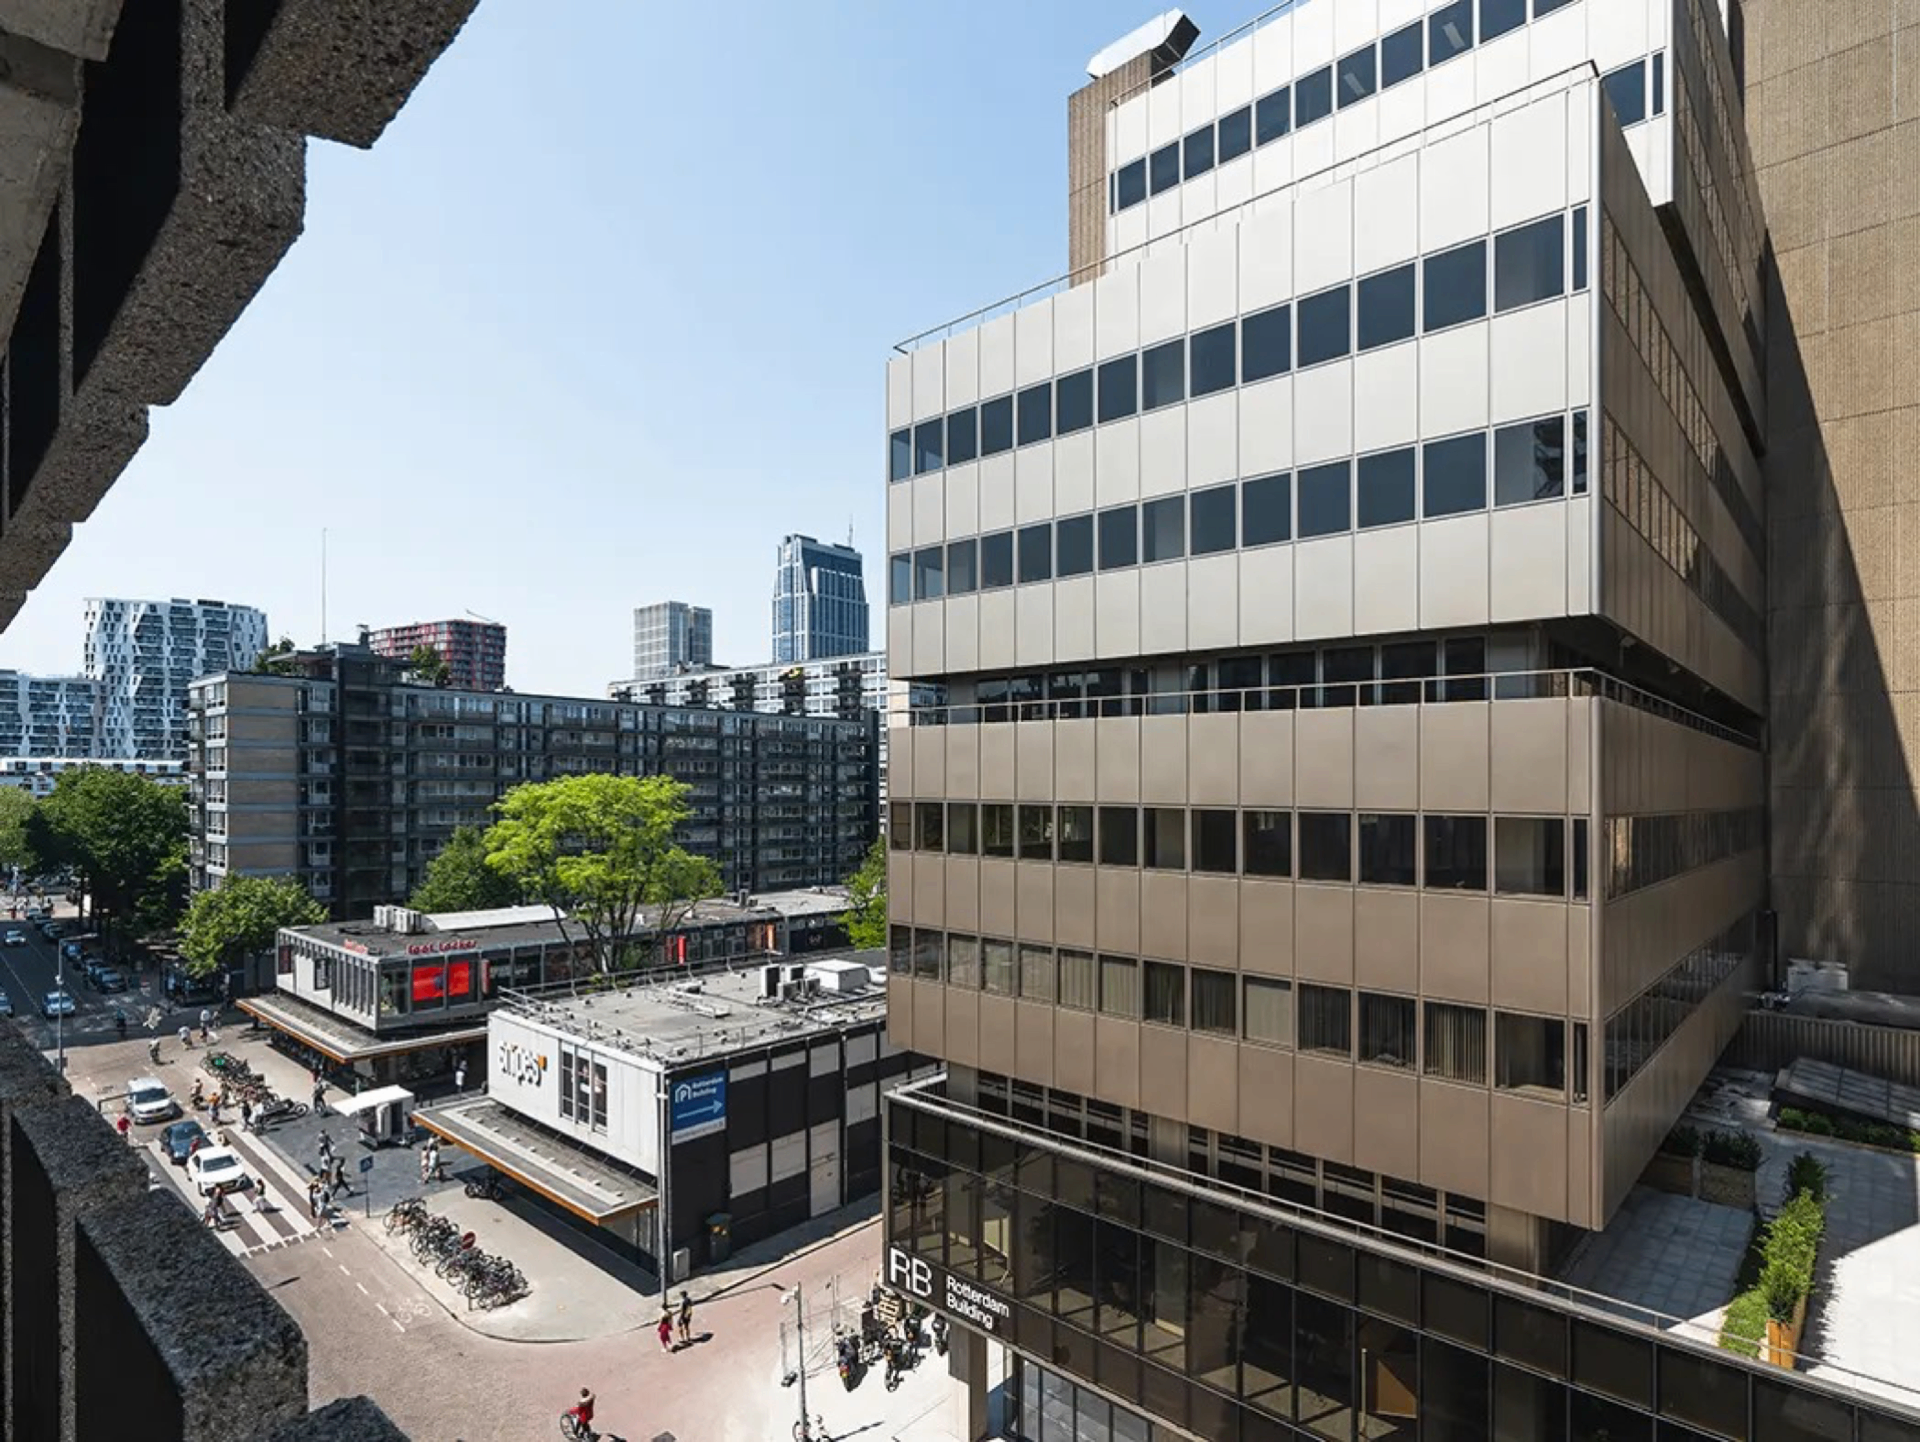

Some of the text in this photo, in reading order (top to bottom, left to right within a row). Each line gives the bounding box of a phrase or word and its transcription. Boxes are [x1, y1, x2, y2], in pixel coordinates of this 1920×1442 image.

[693, 1087, 717, 1097] Building
[890, 1247, 932, 1297] RB
[946, 1274, 1010, 1318] Rotterdam
[946, 1292, 993, 1330] Building
